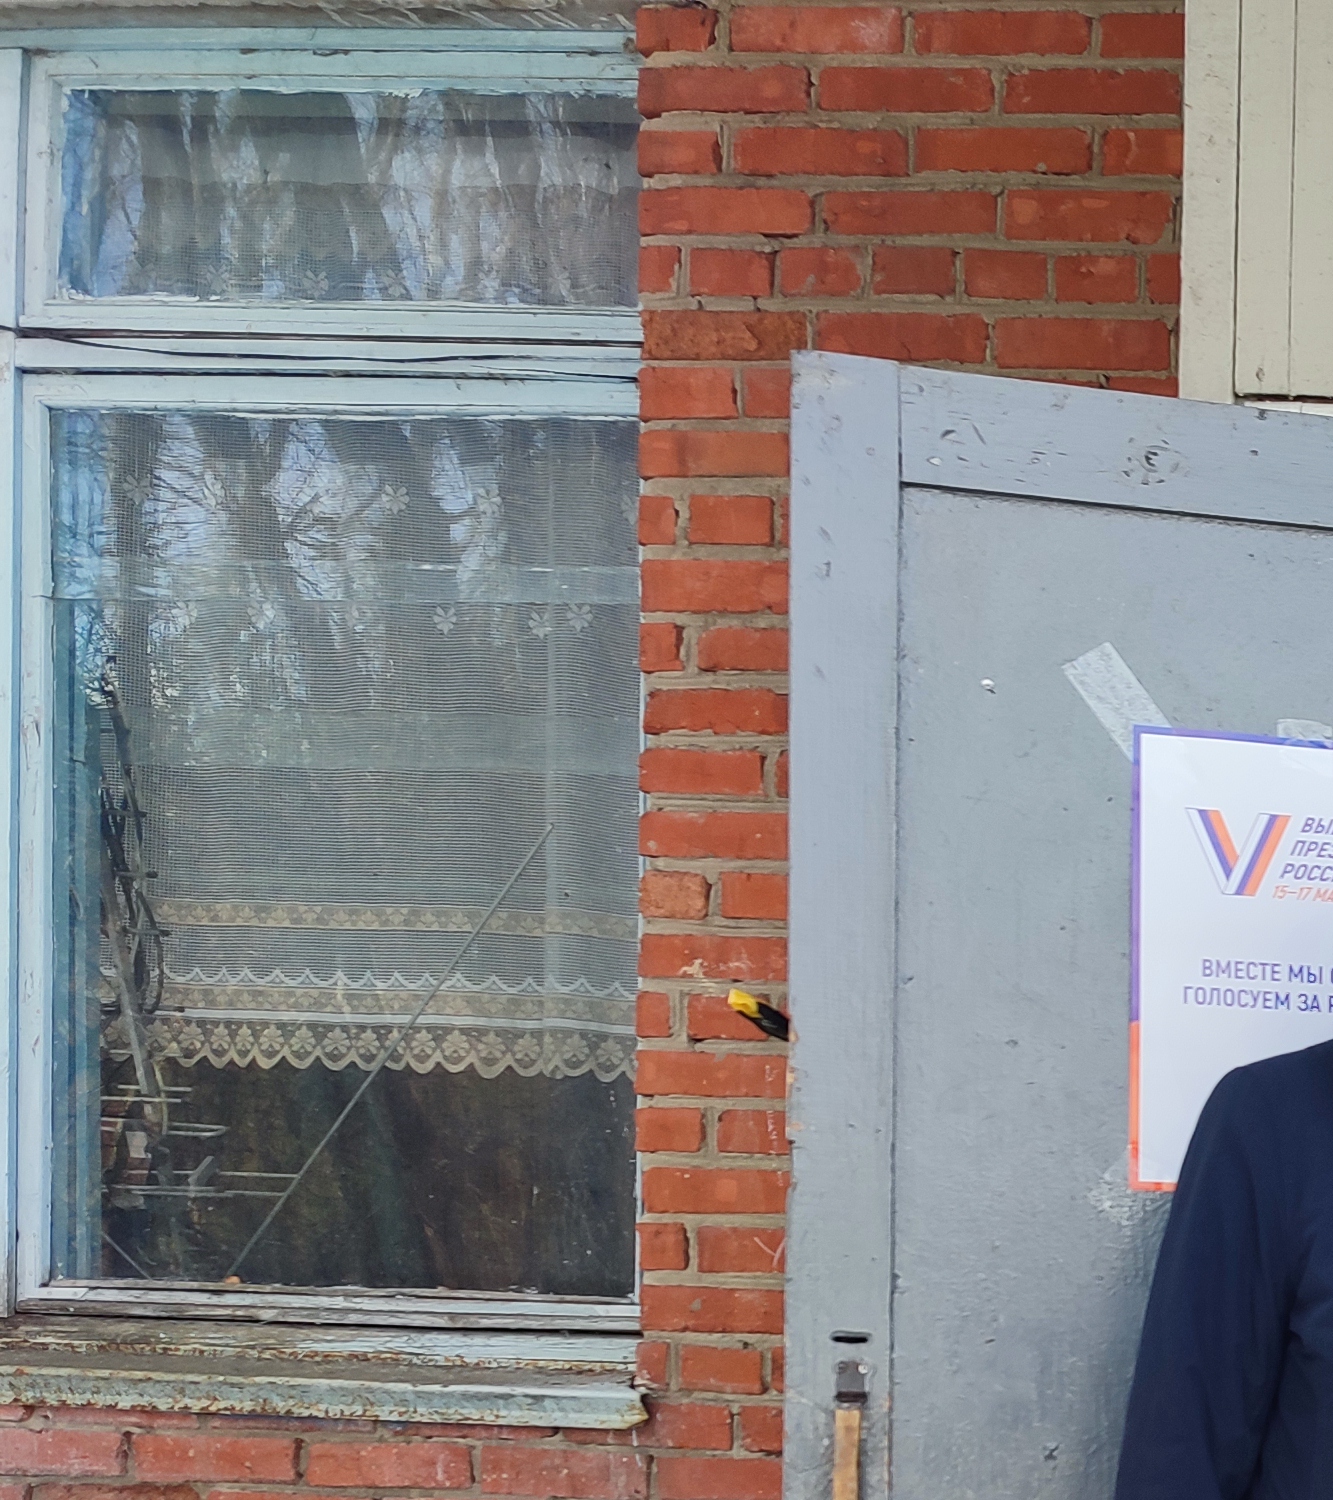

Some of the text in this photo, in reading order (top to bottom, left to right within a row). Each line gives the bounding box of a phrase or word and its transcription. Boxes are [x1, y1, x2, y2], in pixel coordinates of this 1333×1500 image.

[1202, 958, 1282, 982] ВМЕСТЕ
[1288, 964, 1324, 985] МЫ
[1183, 986, 1290, 1011] ГОЛОСУЕМ
[1297, 993, 1321, 1013] ЗА
